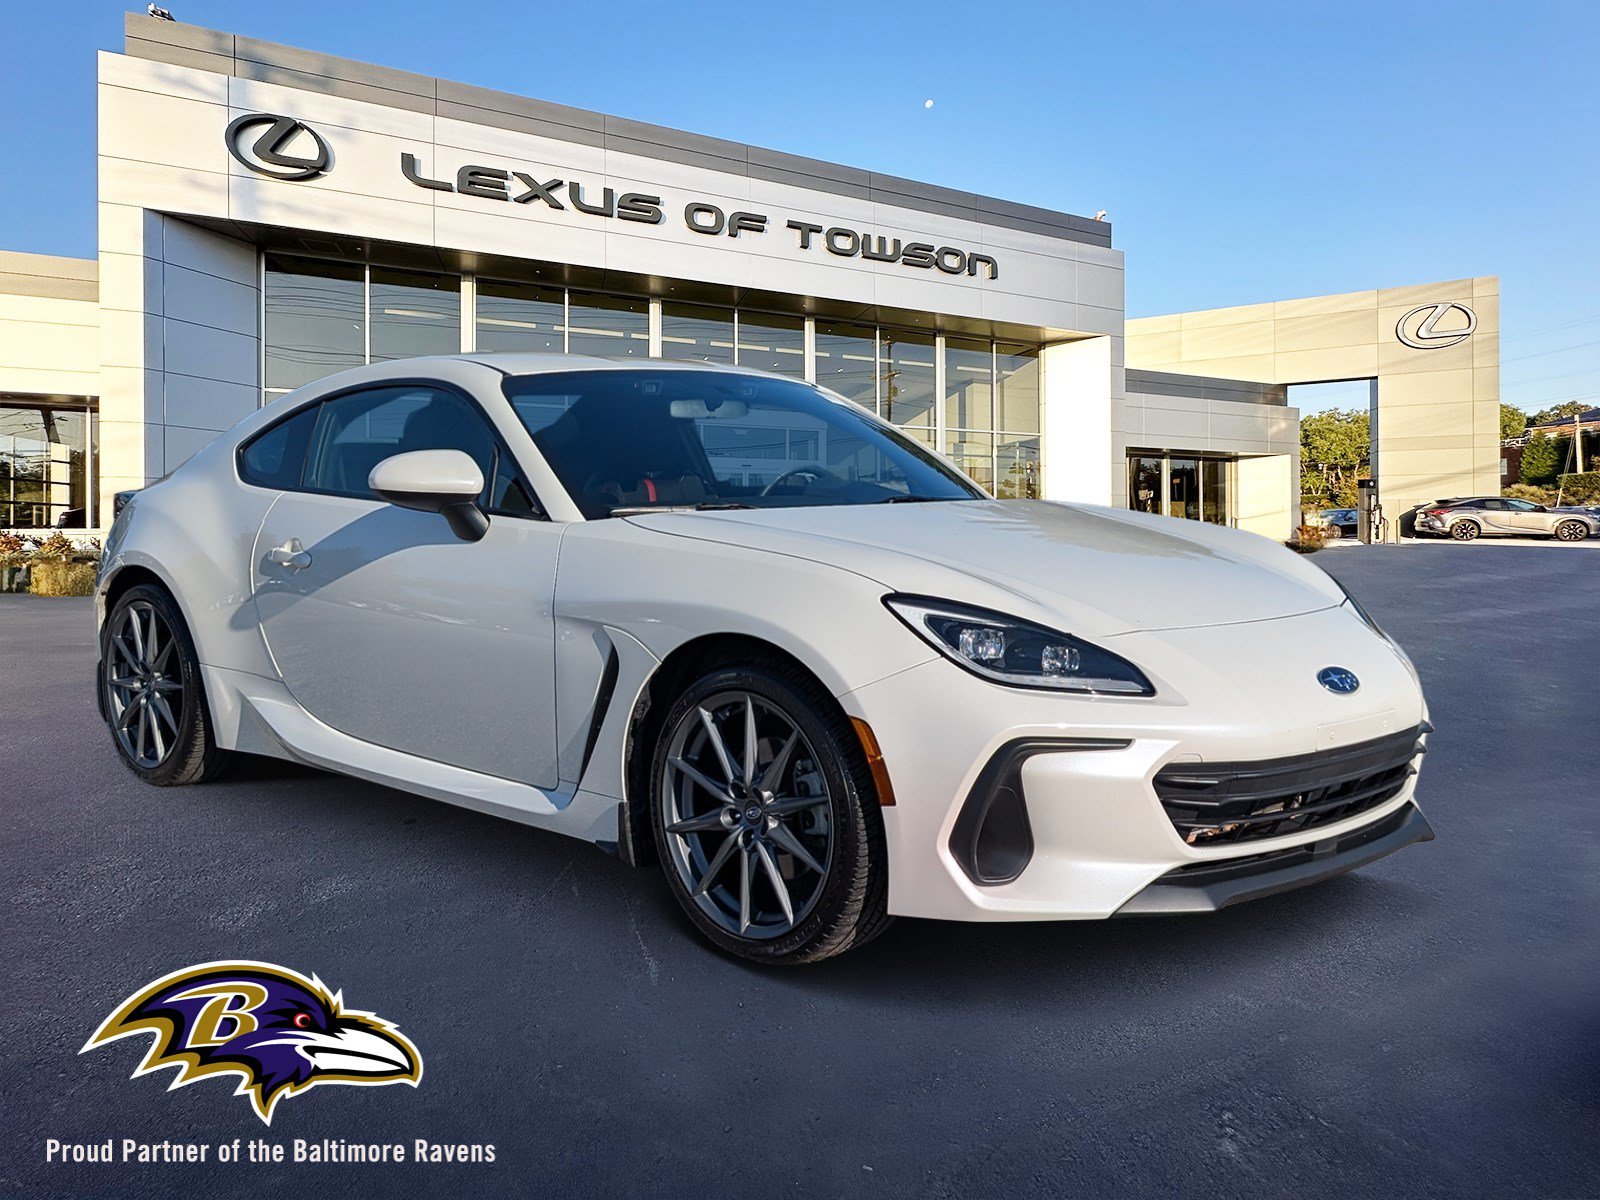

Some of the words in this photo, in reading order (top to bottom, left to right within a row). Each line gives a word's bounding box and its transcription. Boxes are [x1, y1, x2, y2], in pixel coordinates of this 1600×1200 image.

[401, 152, 662, 225] LEXUS
[684, 202, 768, 238] OF
[786, 219, 999, 280] TOWSON
